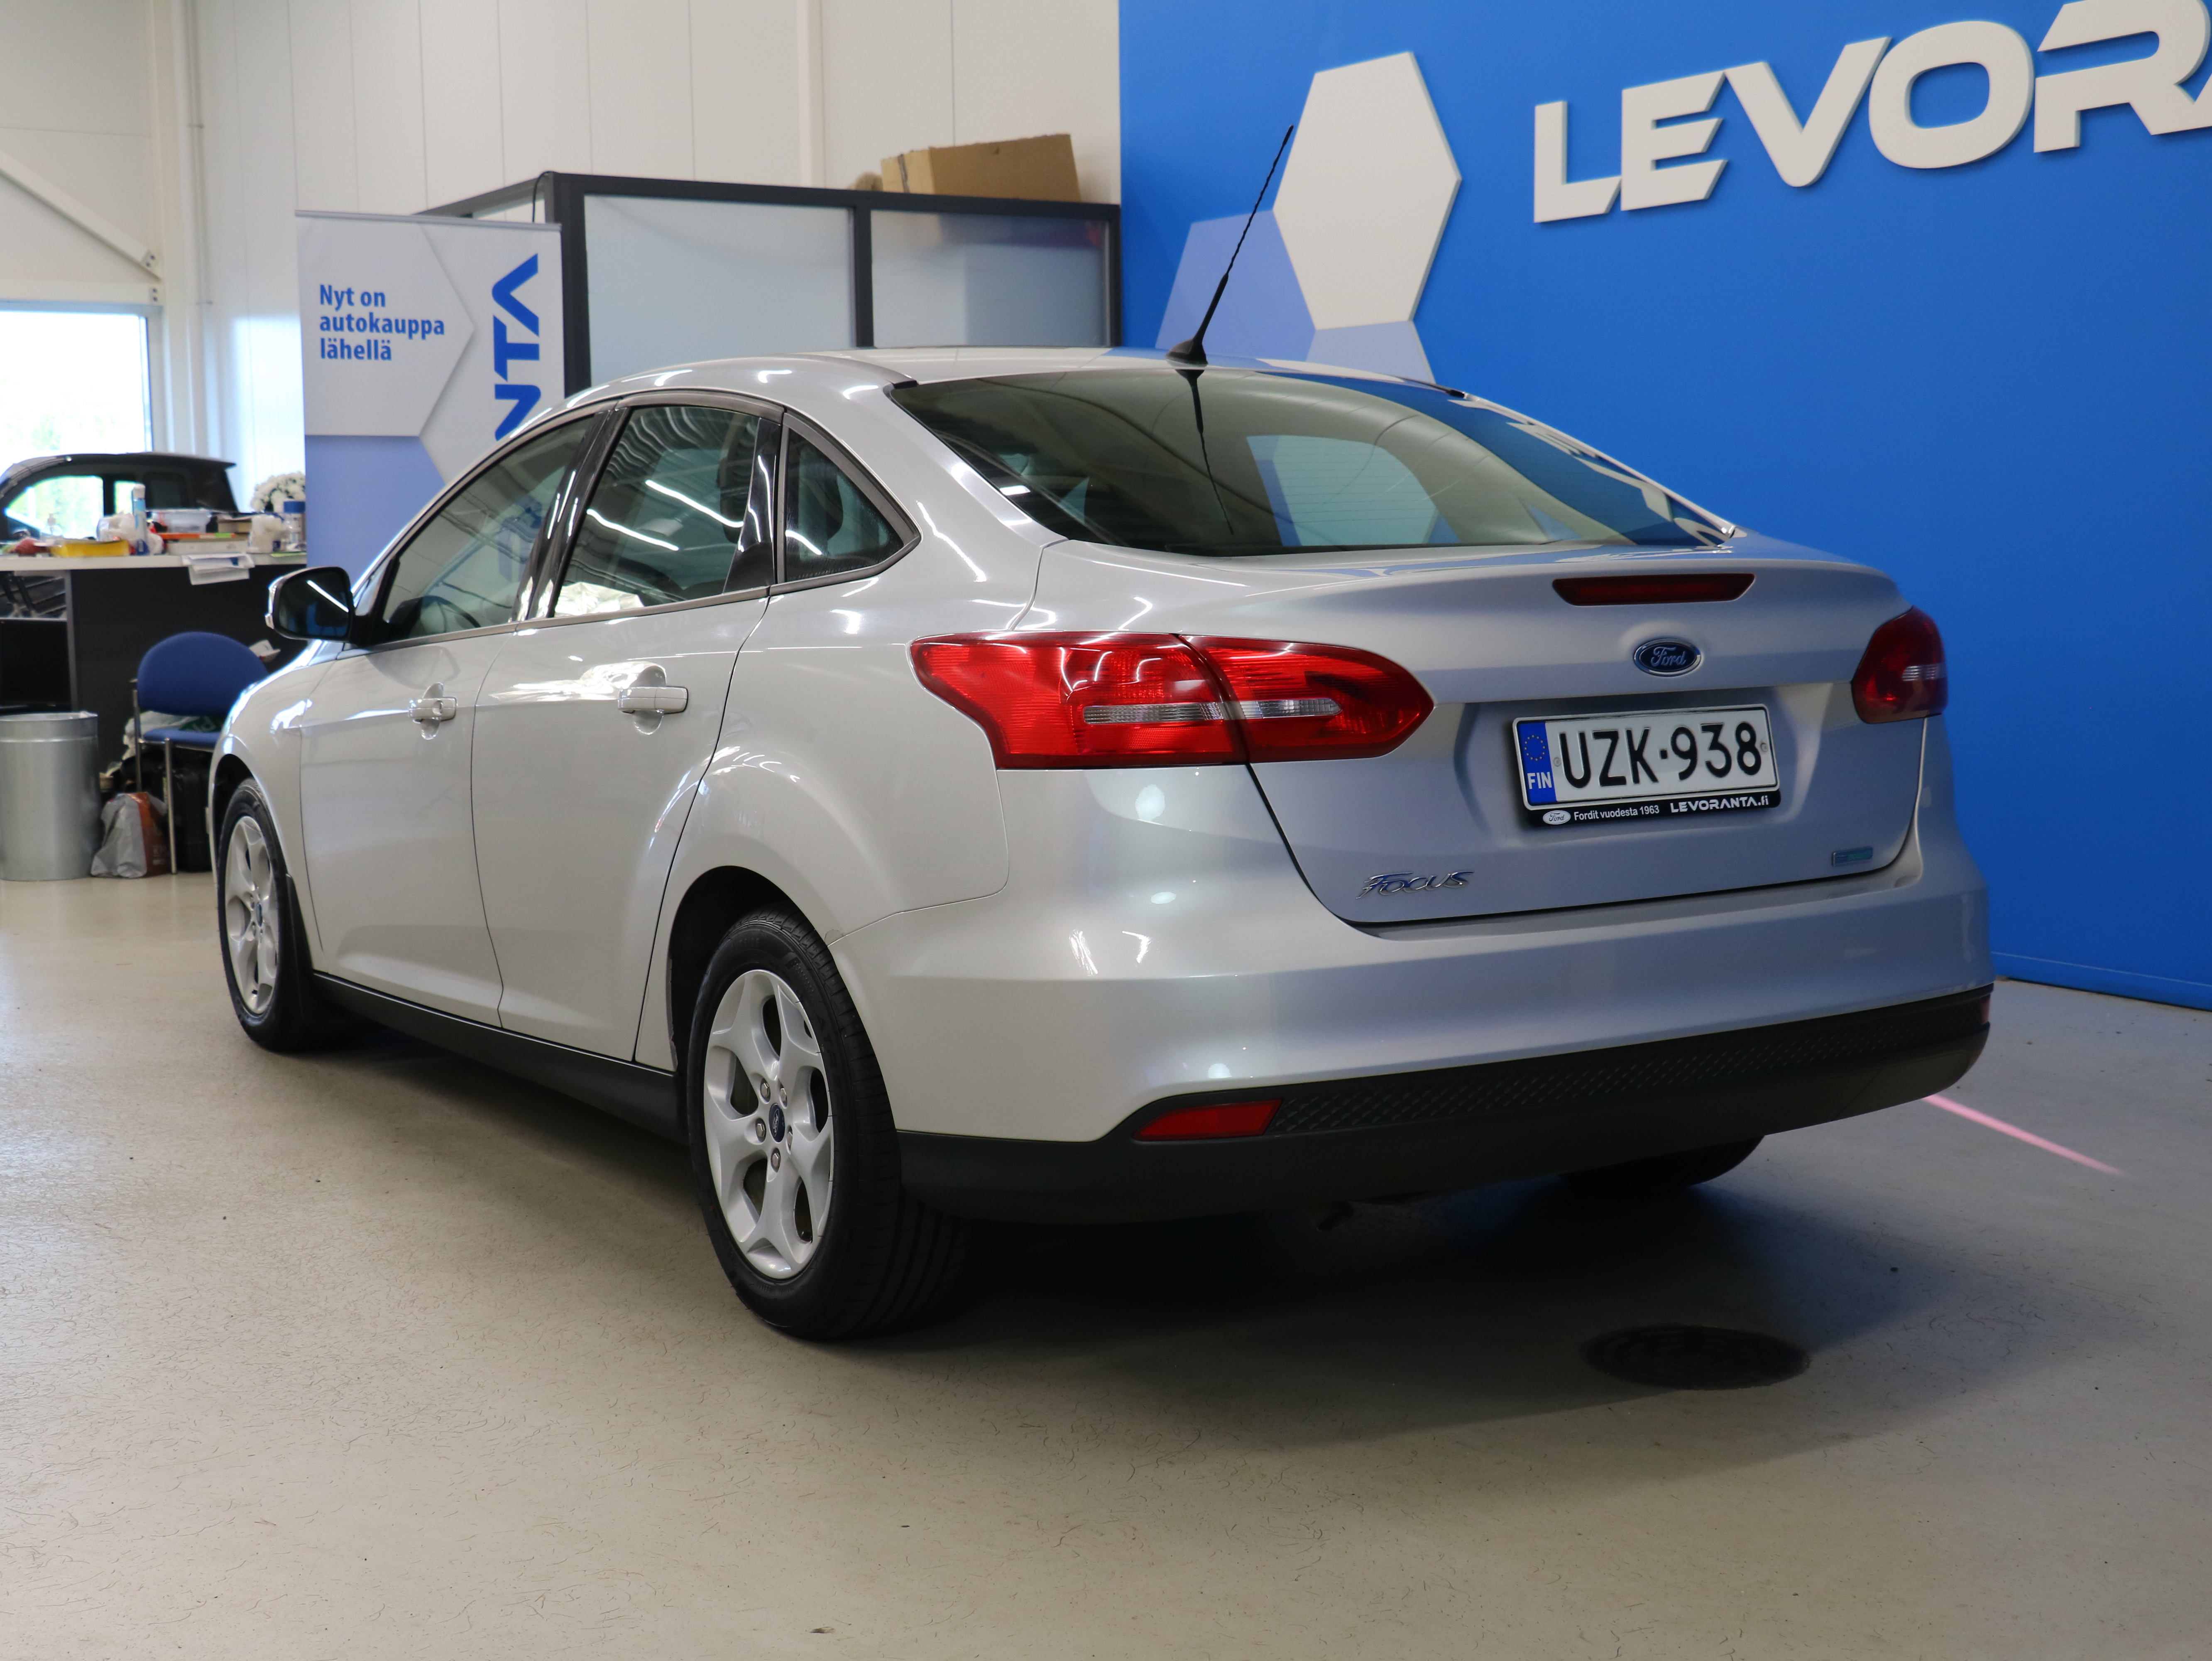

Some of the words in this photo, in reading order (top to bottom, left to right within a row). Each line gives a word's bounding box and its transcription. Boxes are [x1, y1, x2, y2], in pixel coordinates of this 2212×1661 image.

[1534, 0, 2212, 223] LEVOR
[319, 284, 355, 311] Nyt
[360, 290, 386, 307] on
[320, 312, 445, 340] autokauppa
[320, 338, 392, 361] lähellä
[1650, 646, 1687, 667] Ford
[1559, 720, 1762, 789] UZK-938
[1527, 772, 1553, 789] FIN
[1574, 810, 1599, 821] Fordit
[1600, 808, 1638, 818] vuodesta
[1639, 805, 1660, 815] 1963
[1670, 795, 1769, 813] LEVORANTA.fi
[1549, 813, 1565, 822] Ford
